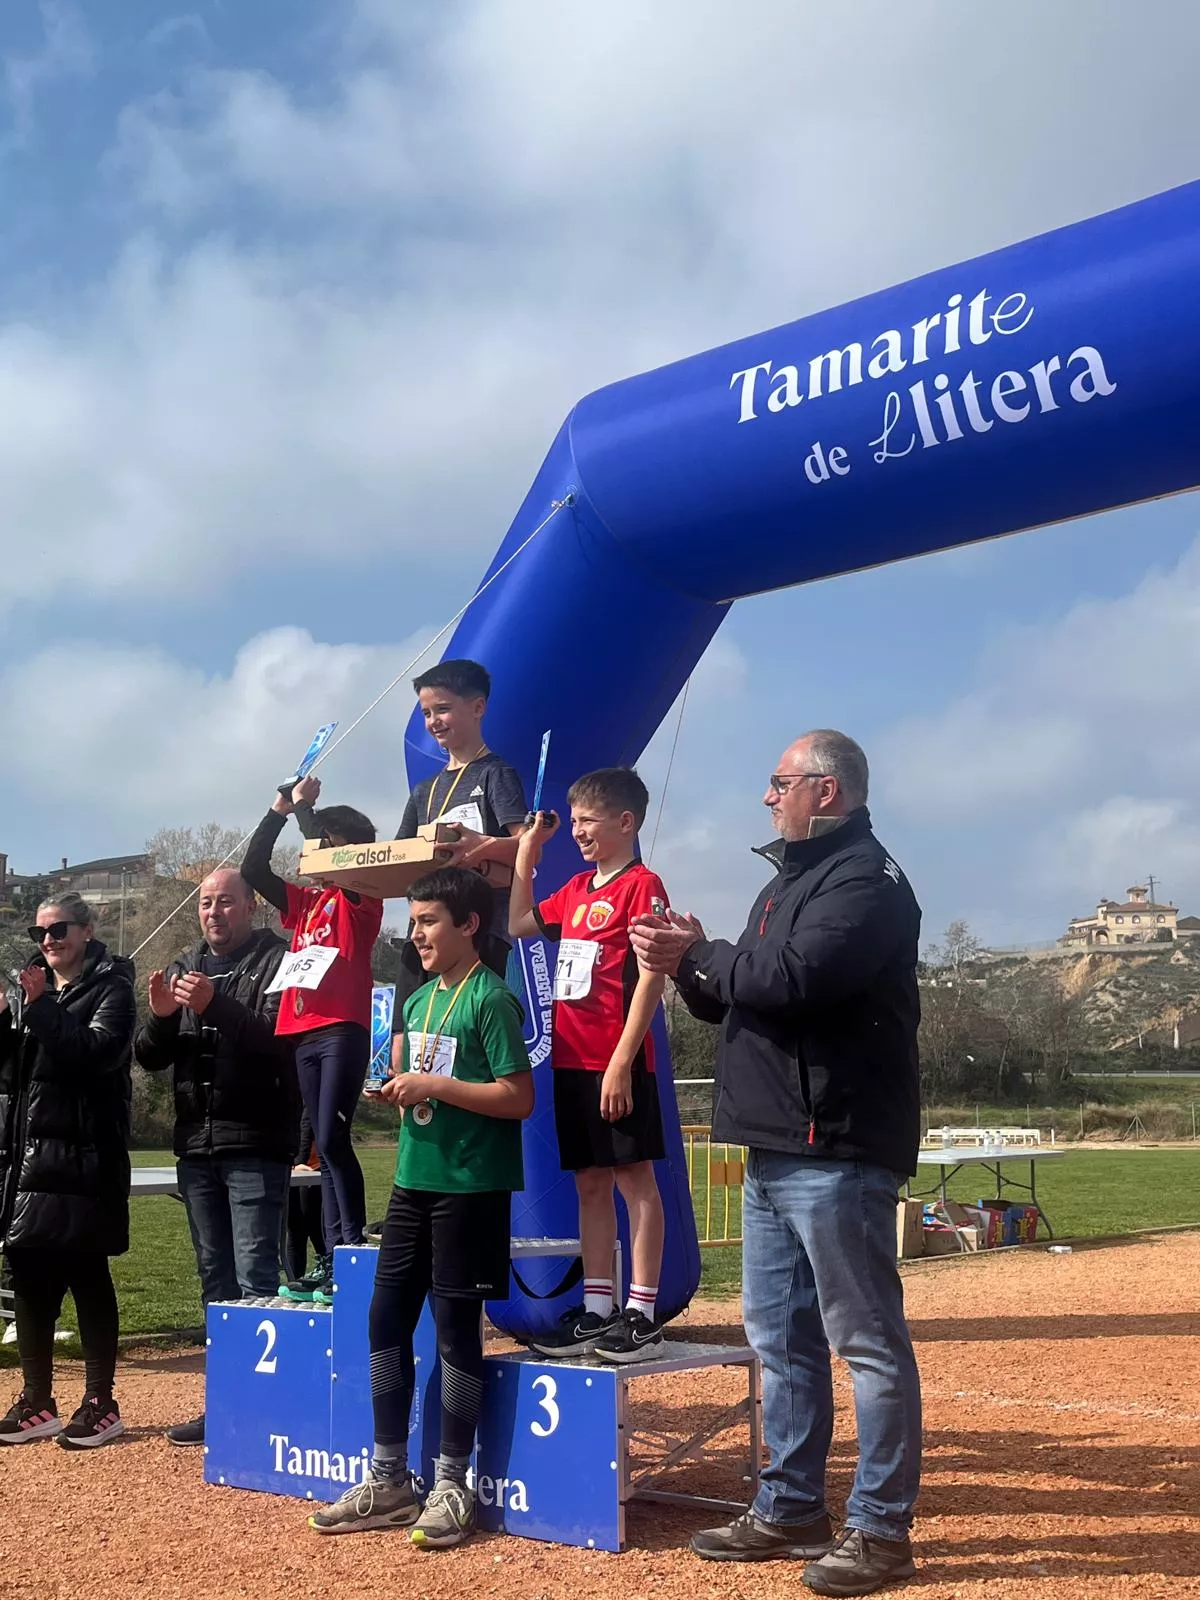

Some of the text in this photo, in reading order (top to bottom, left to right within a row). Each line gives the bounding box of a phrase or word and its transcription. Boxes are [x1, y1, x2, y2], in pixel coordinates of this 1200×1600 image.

[729, 287, 1034, 424] Tamarite
[804, 442, 851, 484] de
[285, 958, 315, 975] 065
[529, 941, 552, 1007] LITERA
[254, 1319, 277, 1373] 2
[530, 1374, 560, 1437] 3
[269, 1433, 374, 1484] Tamari
